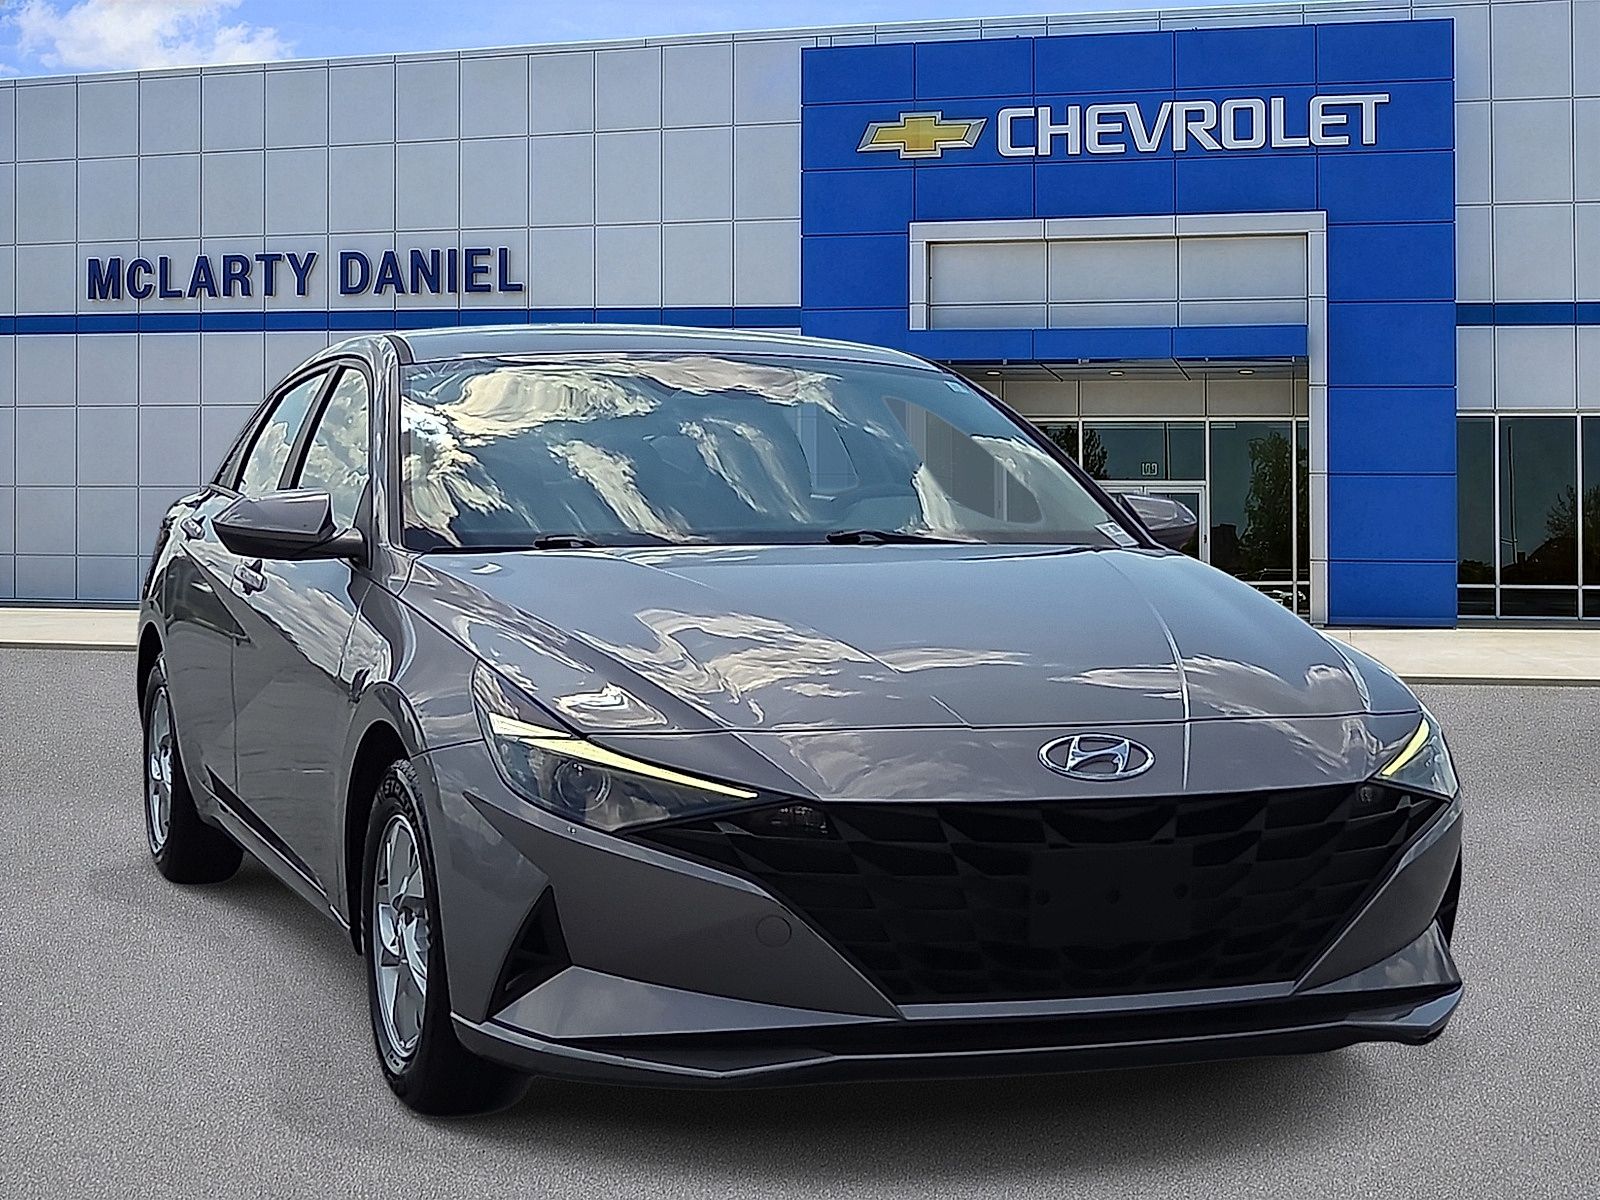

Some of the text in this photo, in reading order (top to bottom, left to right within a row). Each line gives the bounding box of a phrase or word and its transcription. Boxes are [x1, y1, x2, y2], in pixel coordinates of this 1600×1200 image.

[998, 93, 1390, 158] CHEVROLET
[86, 246, 526, 301] MCLARTY DANIEL
